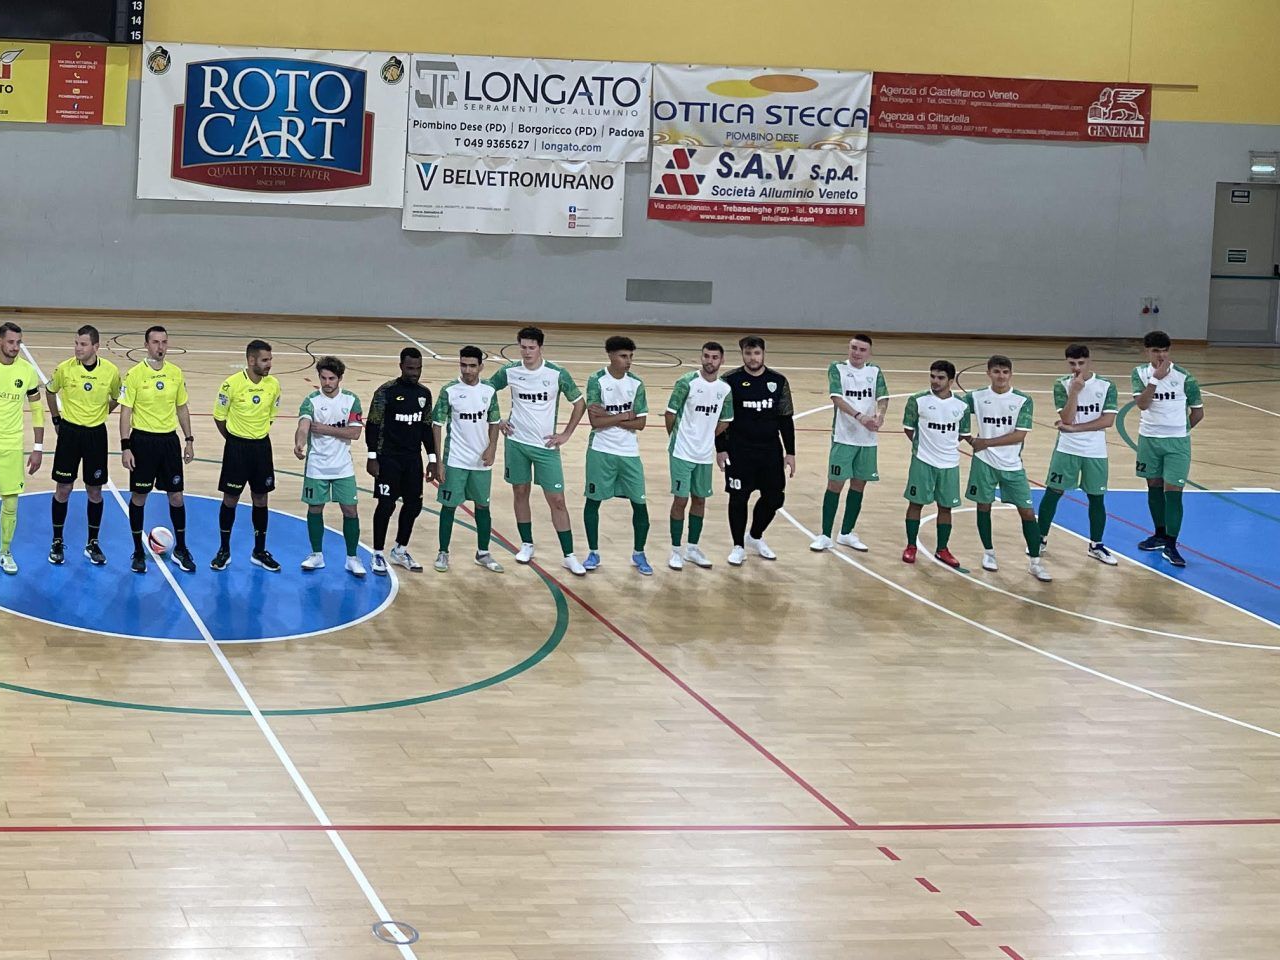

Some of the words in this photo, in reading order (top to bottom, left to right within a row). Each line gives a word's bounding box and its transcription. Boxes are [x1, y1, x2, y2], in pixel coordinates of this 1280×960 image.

[132, 1, 143, 10] 13
[131, 16, 142, 25] 14
[131, 31, 141, 40] 15
[200, 66, 352, 114] ROTO
[464, 71, 641, 108] LONGATO
[880, 85, 916, 96] Agenzia
[920, 87, 927, 95] di
[929, 87, 985, 98] Castelfranco
[988, 90, 1019, 100] Veneto
[464, 104, 538, 113] SERRAMENTI
[572, 109, 638, 117] ALLUMINIO
[654, 100, 754, 124] OTTICA
[765, 105, 868, 128] STECCA
[879, 111, 914, 121] Agenzia
[917, 112, 925, 121] di
[929, 113, 969, 123] Cittadella
[197, 112, 345, 160] CART
[413, 120, 457, 131] Piombino
[460, 123, 482, 132] Dese
[485, 123, 506, 134] (PD)
[518, 124, 571, 136] Borgoricco
[575, 125, 597, 136] (PD)
[609, 128, 644, 138] Padova
[1088, 126, 1144, 138] GENERALI
[726, 132, 773, 141] PIOMBINO
[776, 133, 799, 142] DESE
[455, 138, 461, 147] T
[464, 138, 483, 148] 049
[487, 139, 529, 150] 9365627
[541, 141, 602, 153] longato.com
[207, 165, 257, 178] QUALITY
[263, 167, 297, 178] TISSUE
[299, 169, 331, 181] PAPER
[717, 151, 795, 180] S.A.V.
[810, 164, 858, 184] S.p.A.
[443, 169, 614, 190] BELVETROMURANO
[711, 185, 755, 197] Società
[759, 187, 814, 199] Alluminio
[819, 188, 858, 200] Veneto
[831, 465, 841, 476] 10
[1051, 472, 1063, 483] 21
[304, 487, 313, 499] 11
[378, 484, 390, 496] 12
